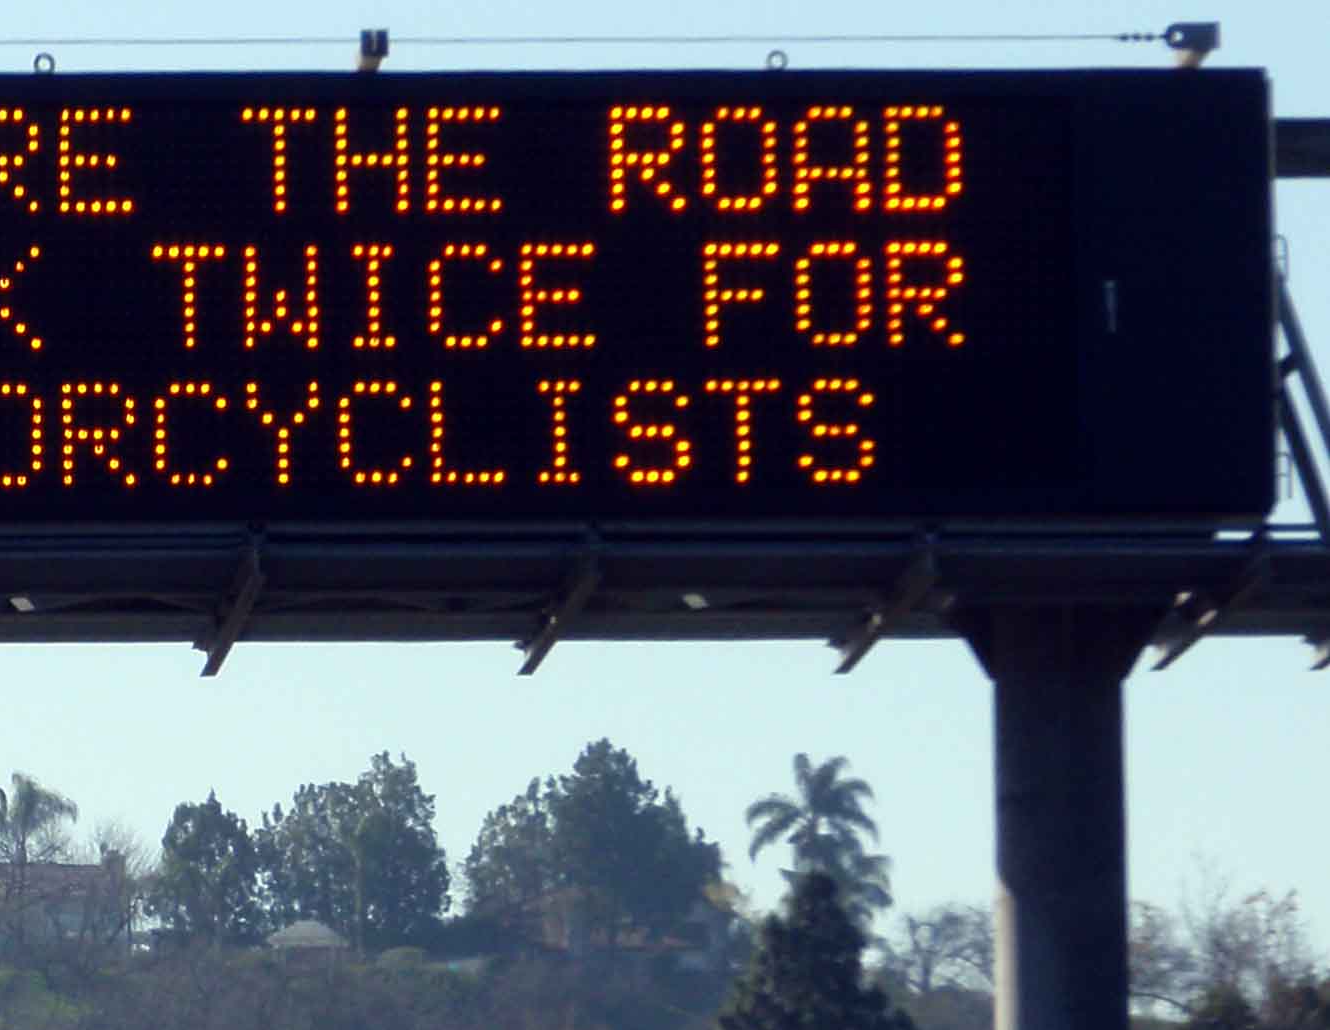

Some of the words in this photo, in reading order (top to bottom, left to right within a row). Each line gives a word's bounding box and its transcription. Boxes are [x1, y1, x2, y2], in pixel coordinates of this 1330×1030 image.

[240, 106, 504, 214] THE
[607, 104, 963, 213] ROAD
[150, 241, 598, 350] TWICE
[701, 239, 965, 348] FOR
